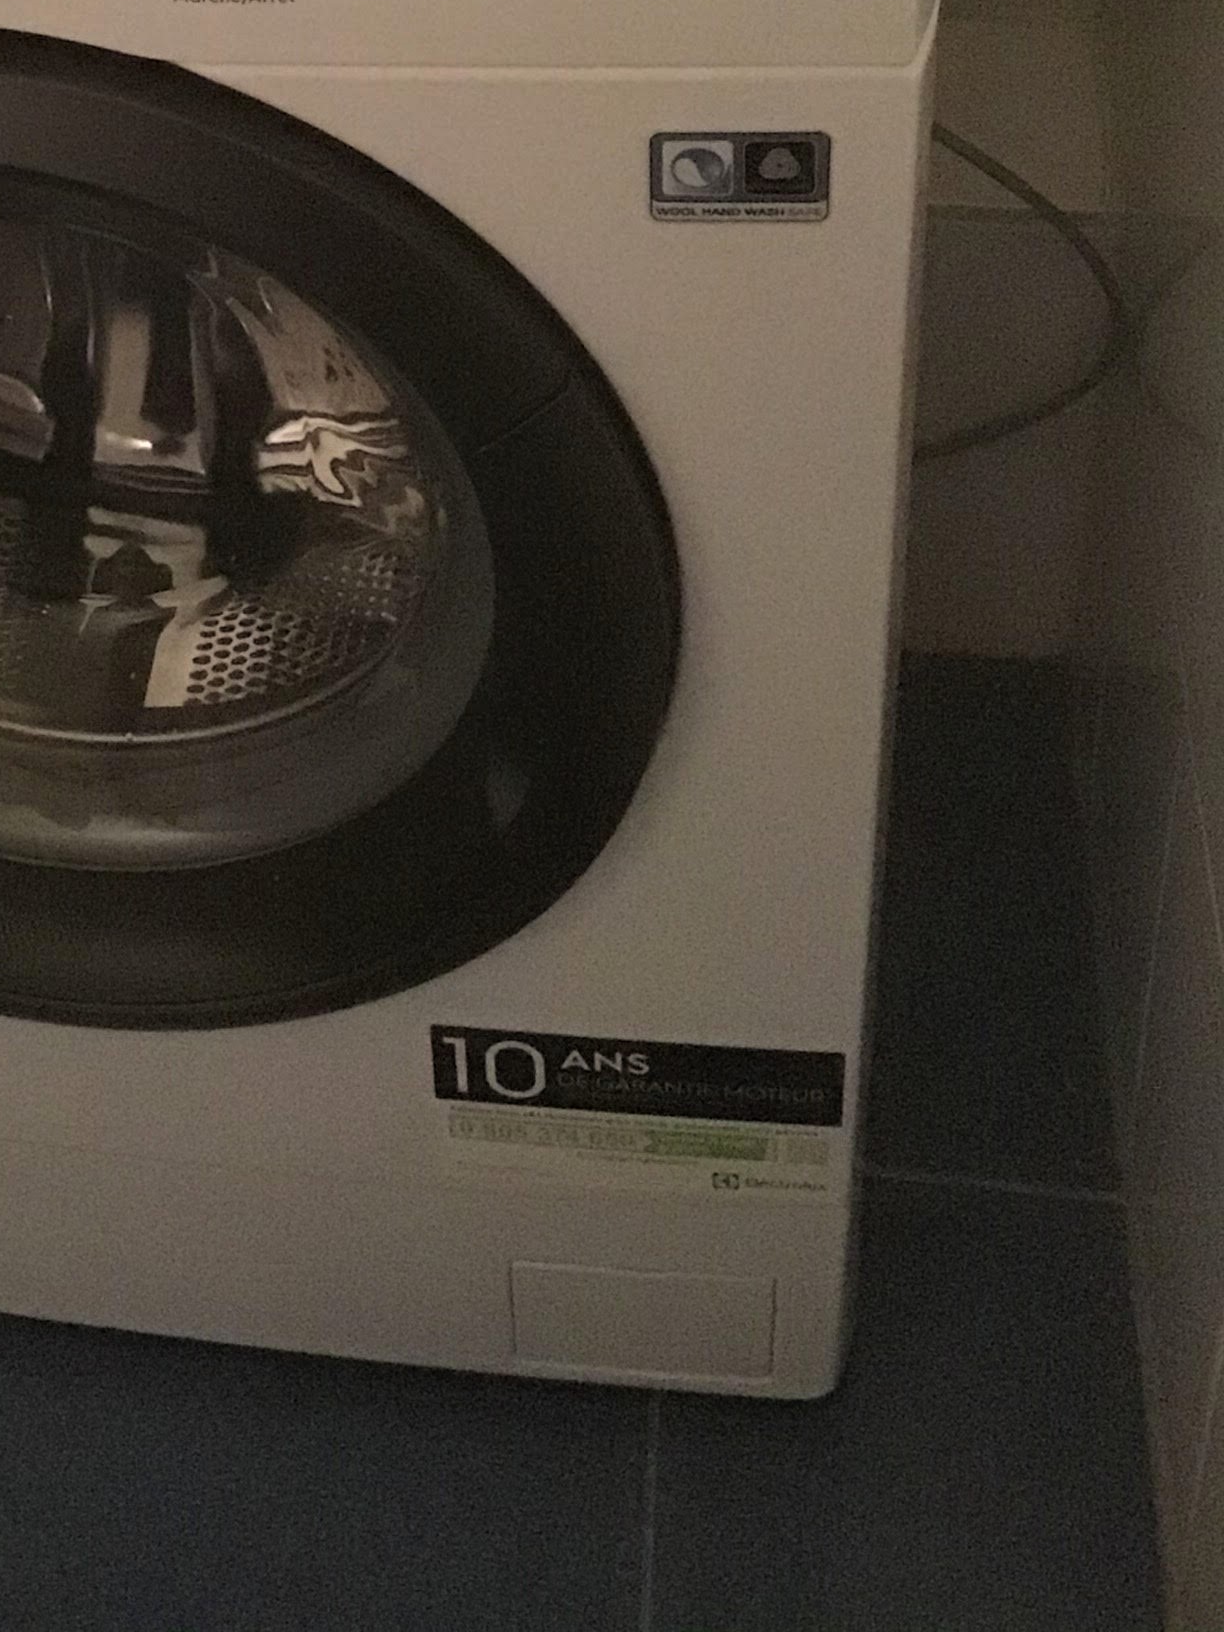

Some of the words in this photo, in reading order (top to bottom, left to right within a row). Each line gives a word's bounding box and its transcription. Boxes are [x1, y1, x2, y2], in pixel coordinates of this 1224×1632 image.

[656, 206, 697, 216] WOOL
[702, 207, 741, 216] HAND
[744, 207, 784, 216] WASH
[443, 1036, 547, 1099] 10
[559, 1051, 651, 1076] ANS
